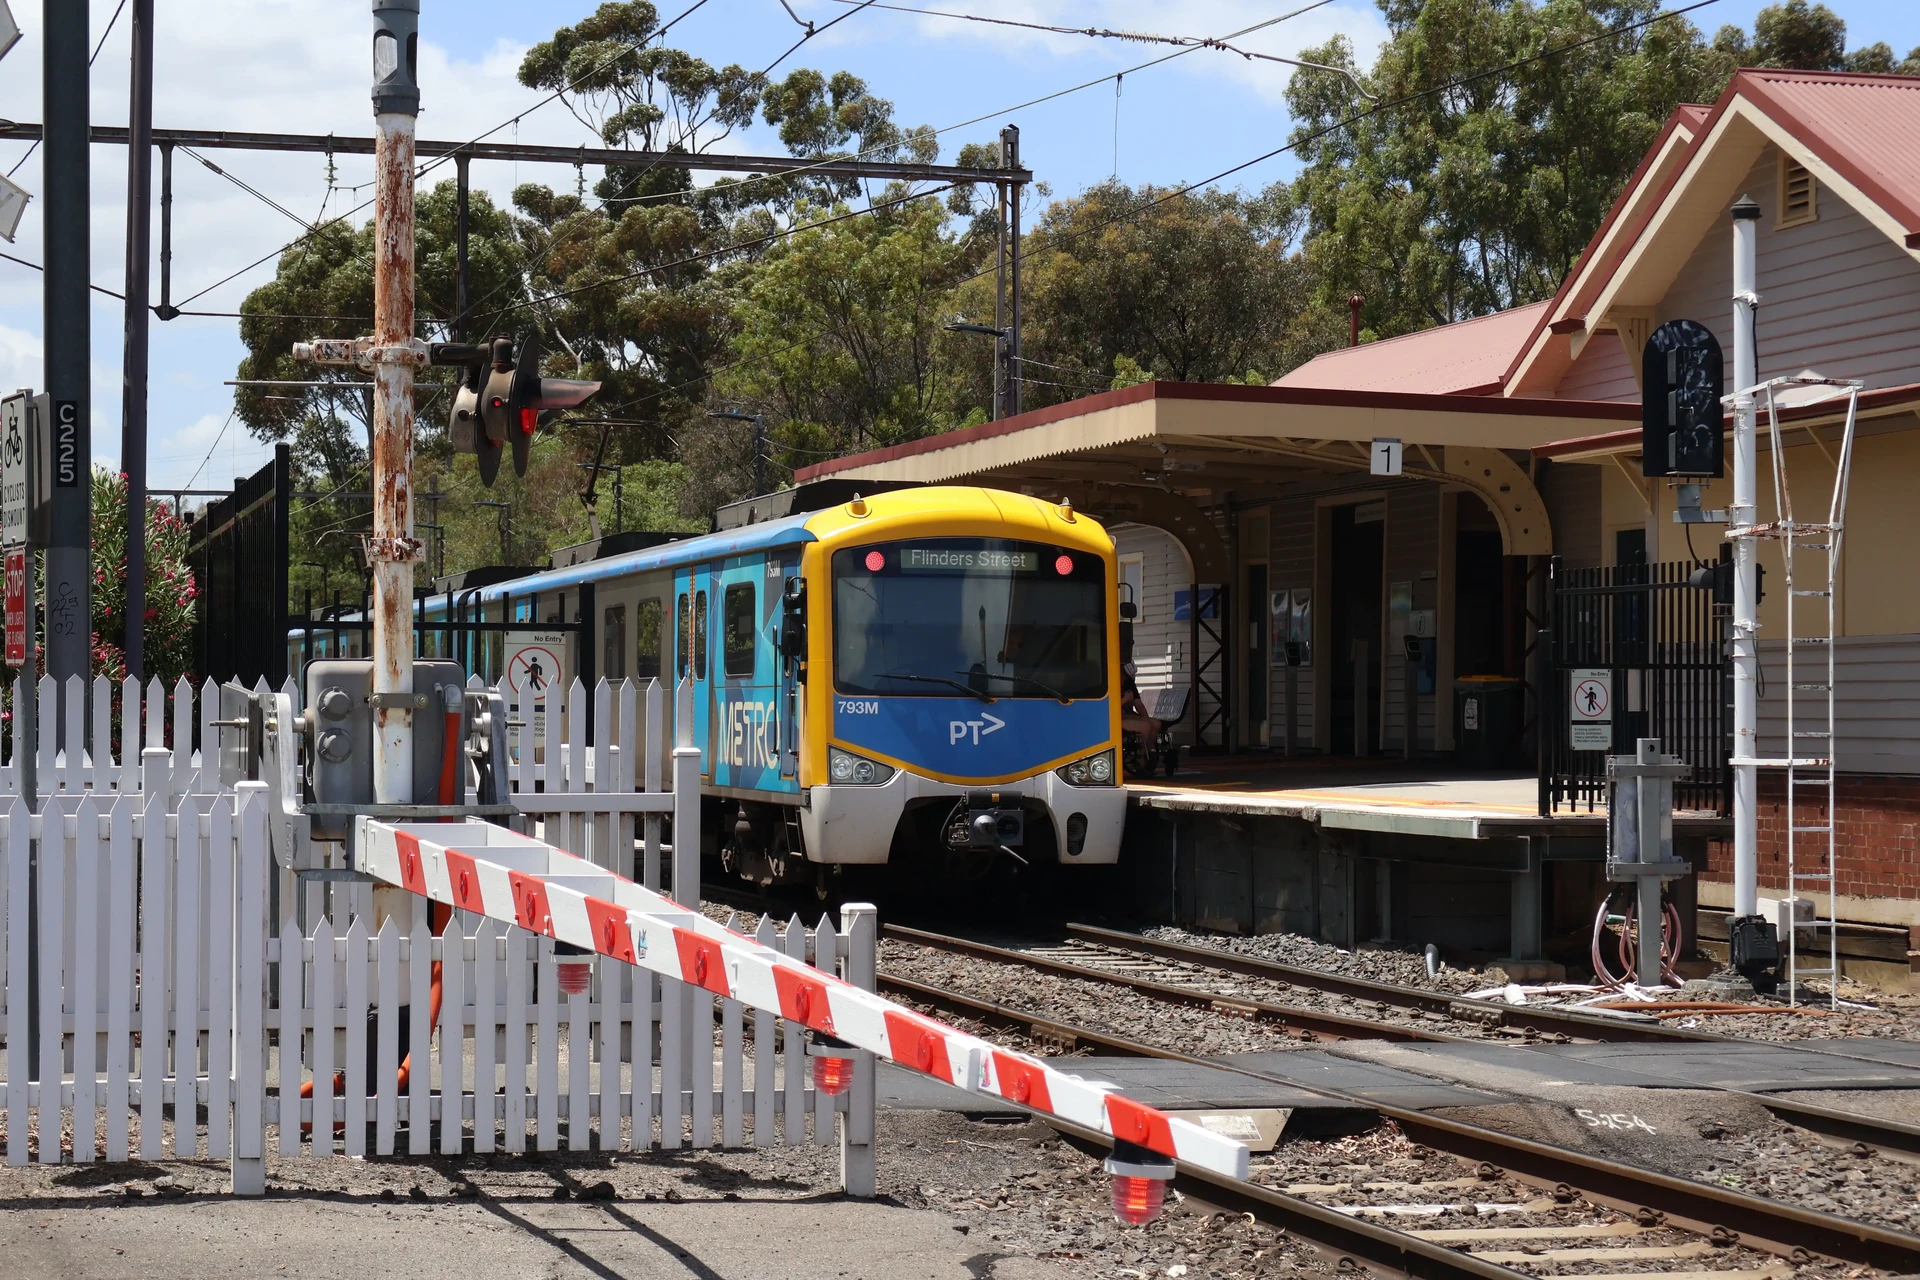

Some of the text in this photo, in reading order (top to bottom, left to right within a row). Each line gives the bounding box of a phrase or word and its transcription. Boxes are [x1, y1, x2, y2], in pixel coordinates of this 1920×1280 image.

[59, 404, 75, 483] C225
[1380, 445, 1391, 473] 1
[4, 481, 25, 503] CYCLISTS
[3, 506, 25, 528] DISMOUNT
[766, 560, 781, 578] 793M
[911, 549, 1026, 568] Flinders Street
[6, 570, 23, 599] STOP
[838, 701, 879, 715] 793M
[719, 700, 781, 770] METRO
